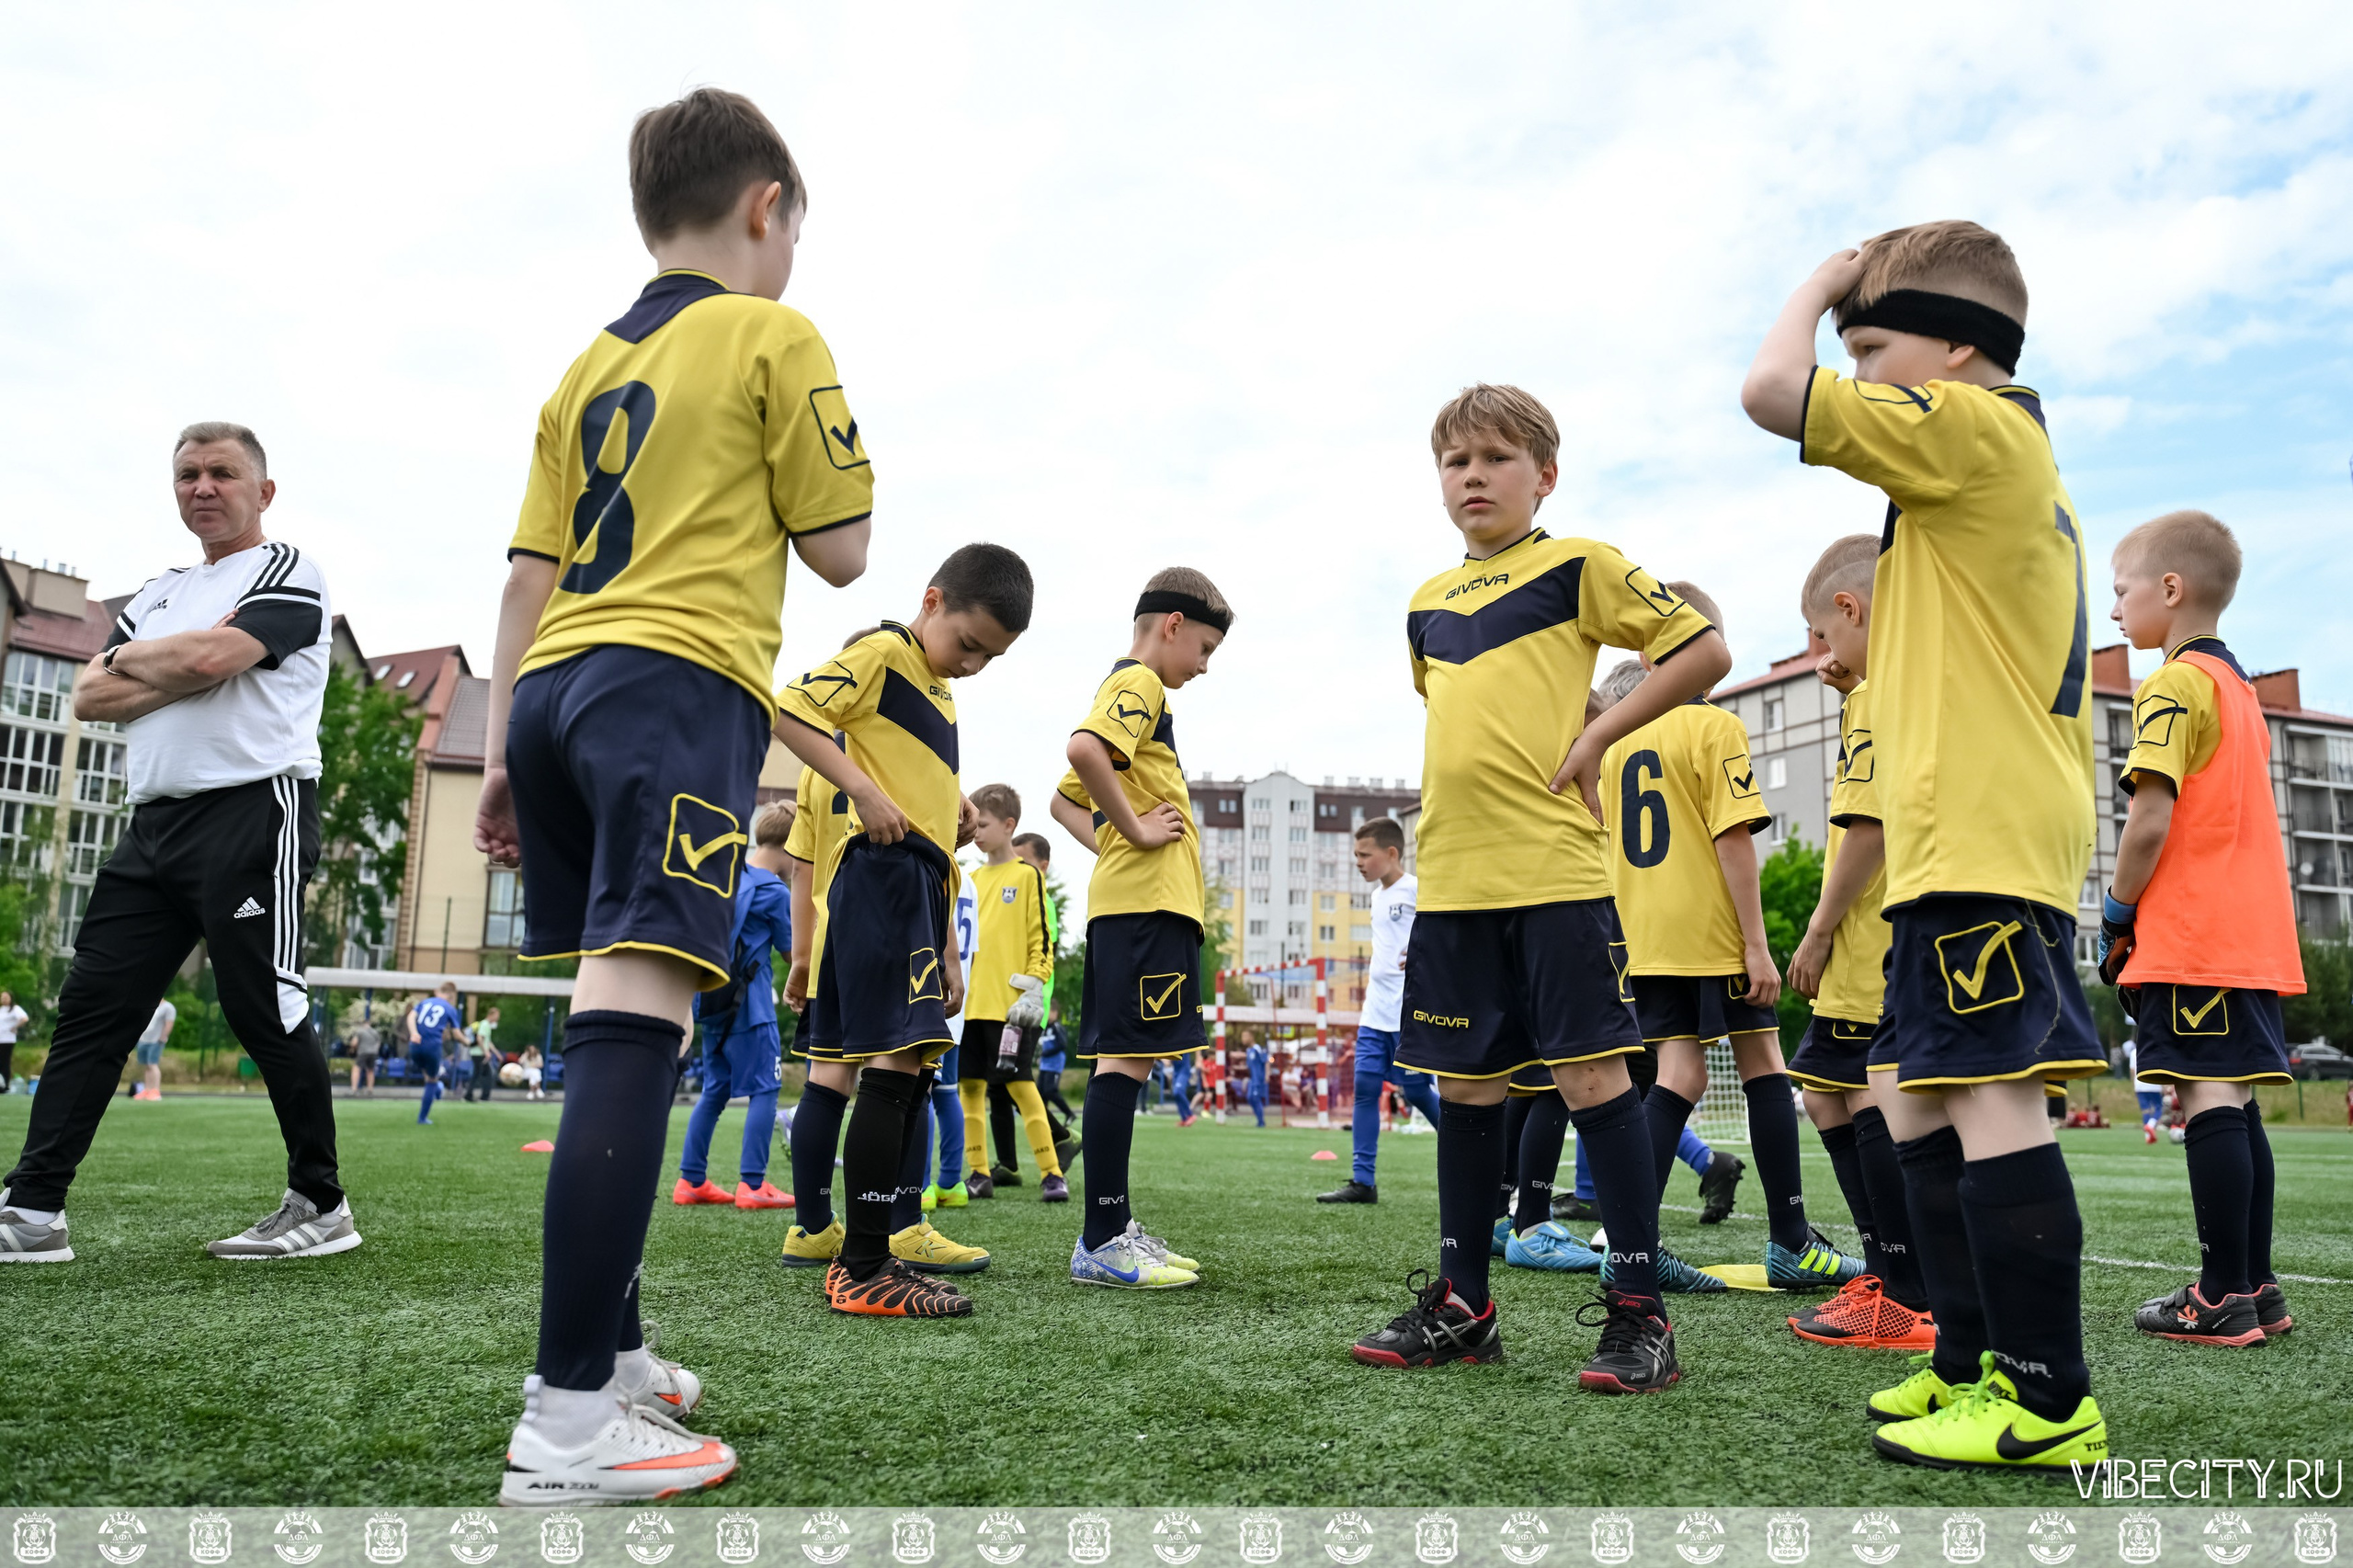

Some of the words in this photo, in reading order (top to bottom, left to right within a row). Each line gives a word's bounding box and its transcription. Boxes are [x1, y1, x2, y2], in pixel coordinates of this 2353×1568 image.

[559, 380, 656, 595] 8
[1445, 573, 1509, 600] GIVOVA
[1621, 749, 1670, 869] 6
[233, 908, 266, 919] adidas
[957, 897, 972, 960] 5
[417, 1003, 446, 1028] 13
[1413, 1009, 1470, 1028] GIVOVA
[774, 1056, 781, 1081] 5
[528, 1482, 564, 1490] AIR
